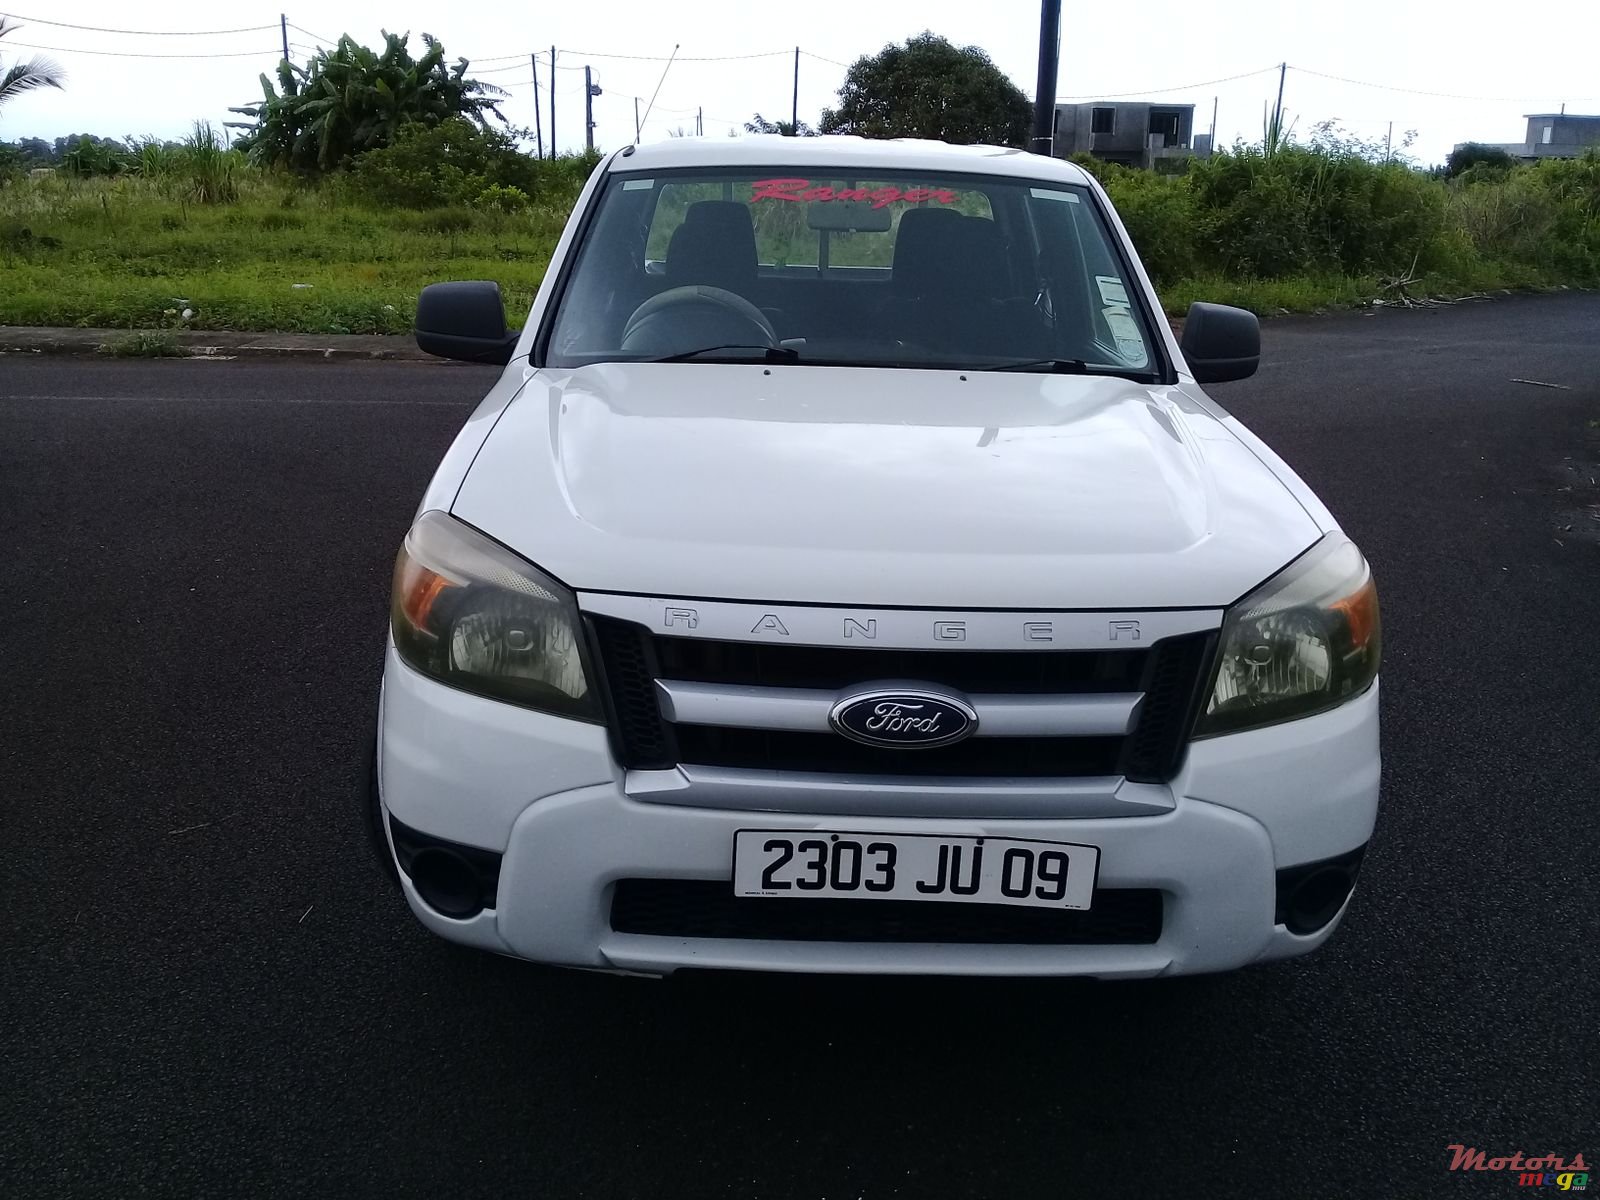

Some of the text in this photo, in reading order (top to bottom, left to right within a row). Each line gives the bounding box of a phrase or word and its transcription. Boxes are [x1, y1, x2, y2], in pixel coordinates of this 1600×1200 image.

[751, 178, 960, 209] Ranger
[664, 607, 1142, 642] RANGER
[866, 702, 942, 733] Ford
[761, 839, 1070, 901] 2303 JU 09
